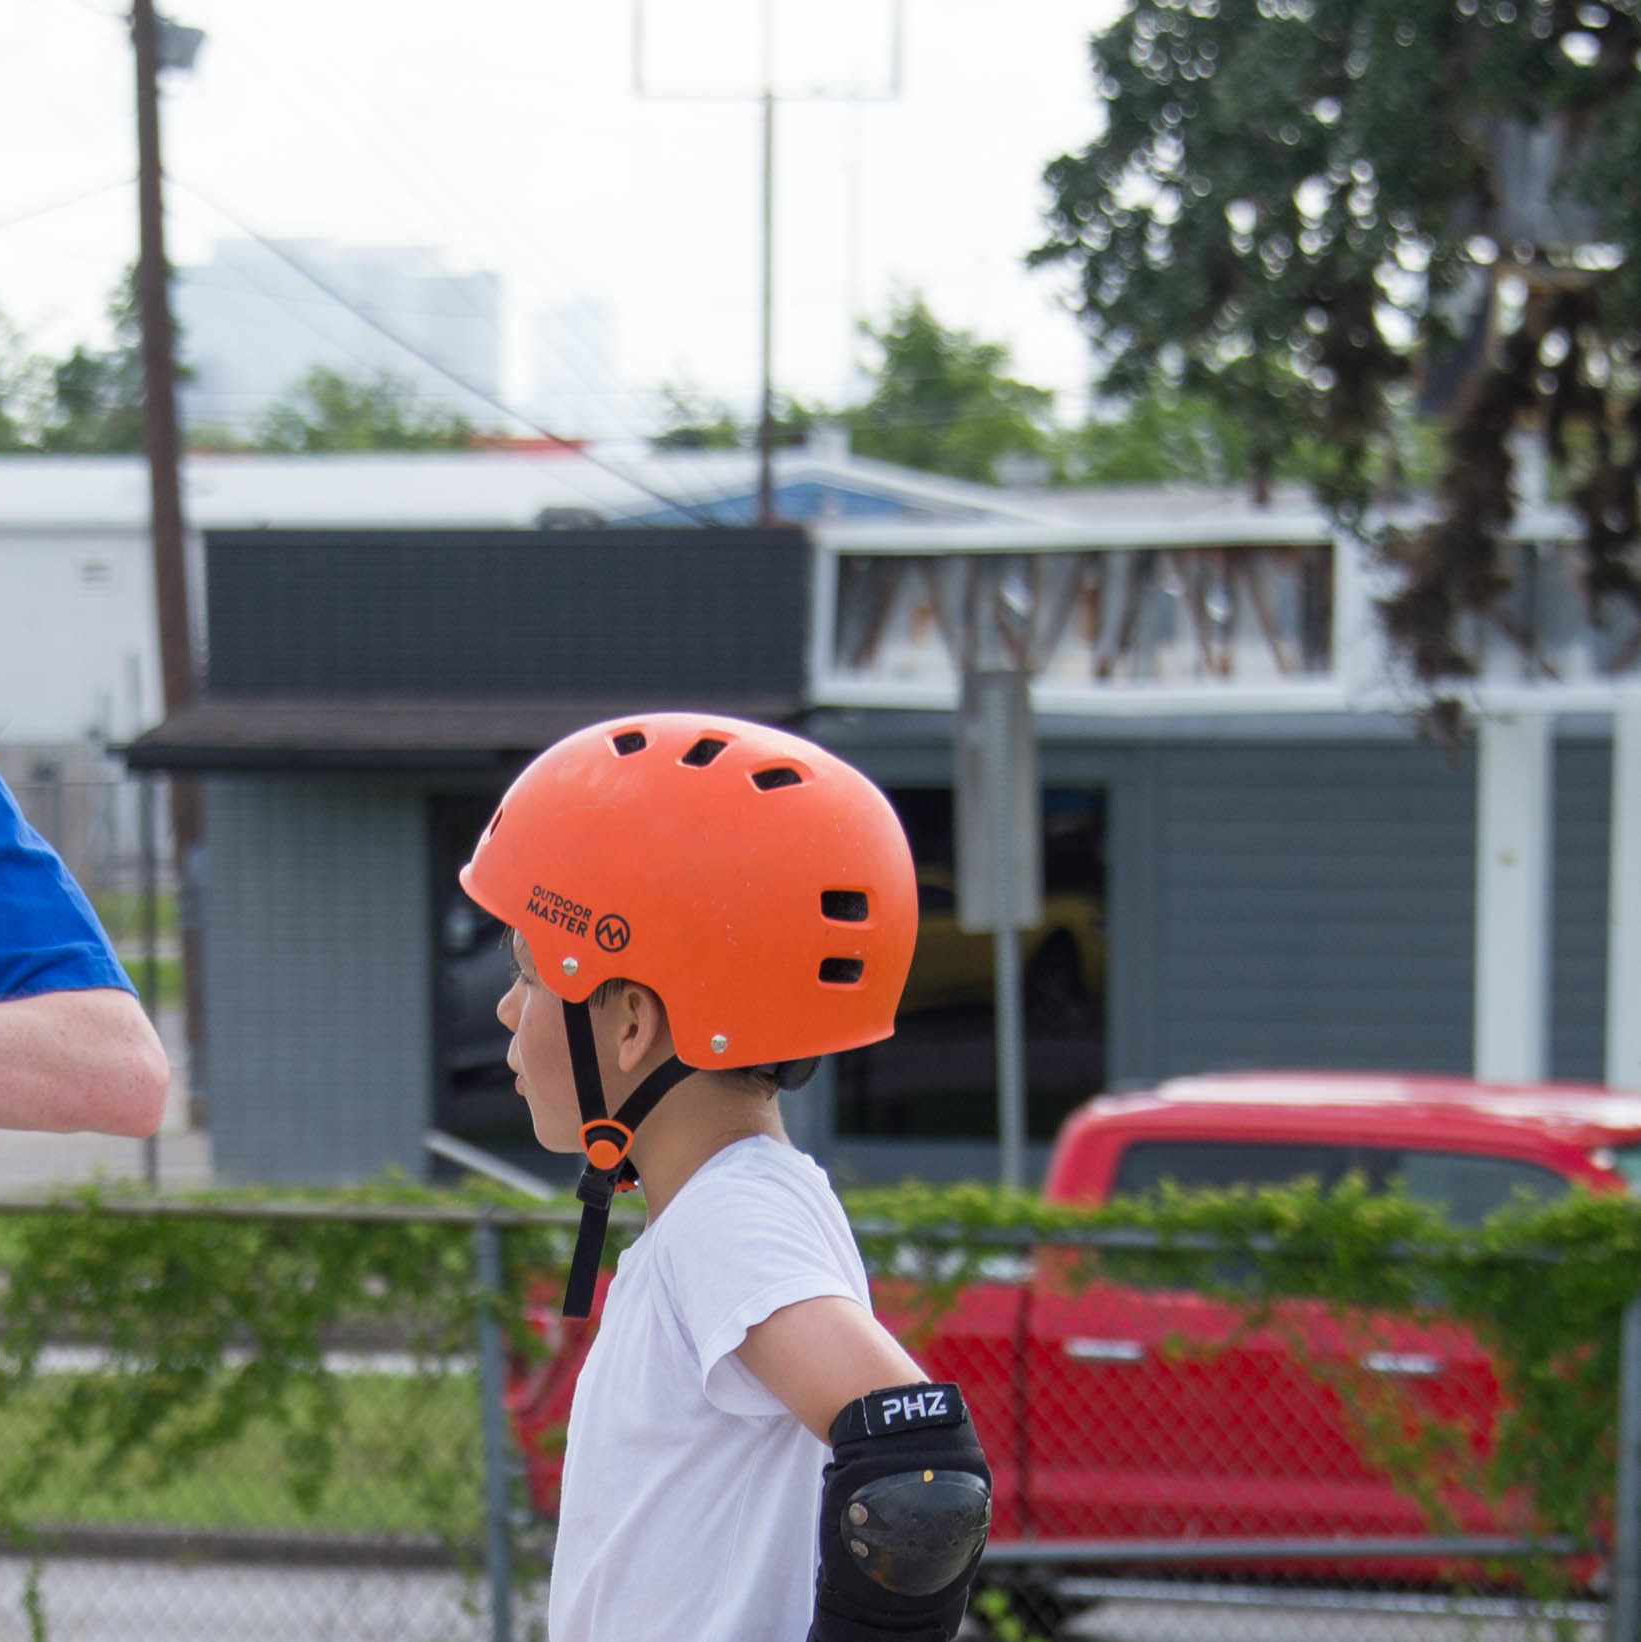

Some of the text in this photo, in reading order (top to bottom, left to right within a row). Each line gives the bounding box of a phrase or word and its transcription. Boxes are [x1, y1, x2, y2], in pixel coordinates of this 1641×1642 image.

[525, 898, 589, 938] MASTER
[532, 885, 593, 922] OUTDOOR
[881, 1391, 948, 1425] PHZ
